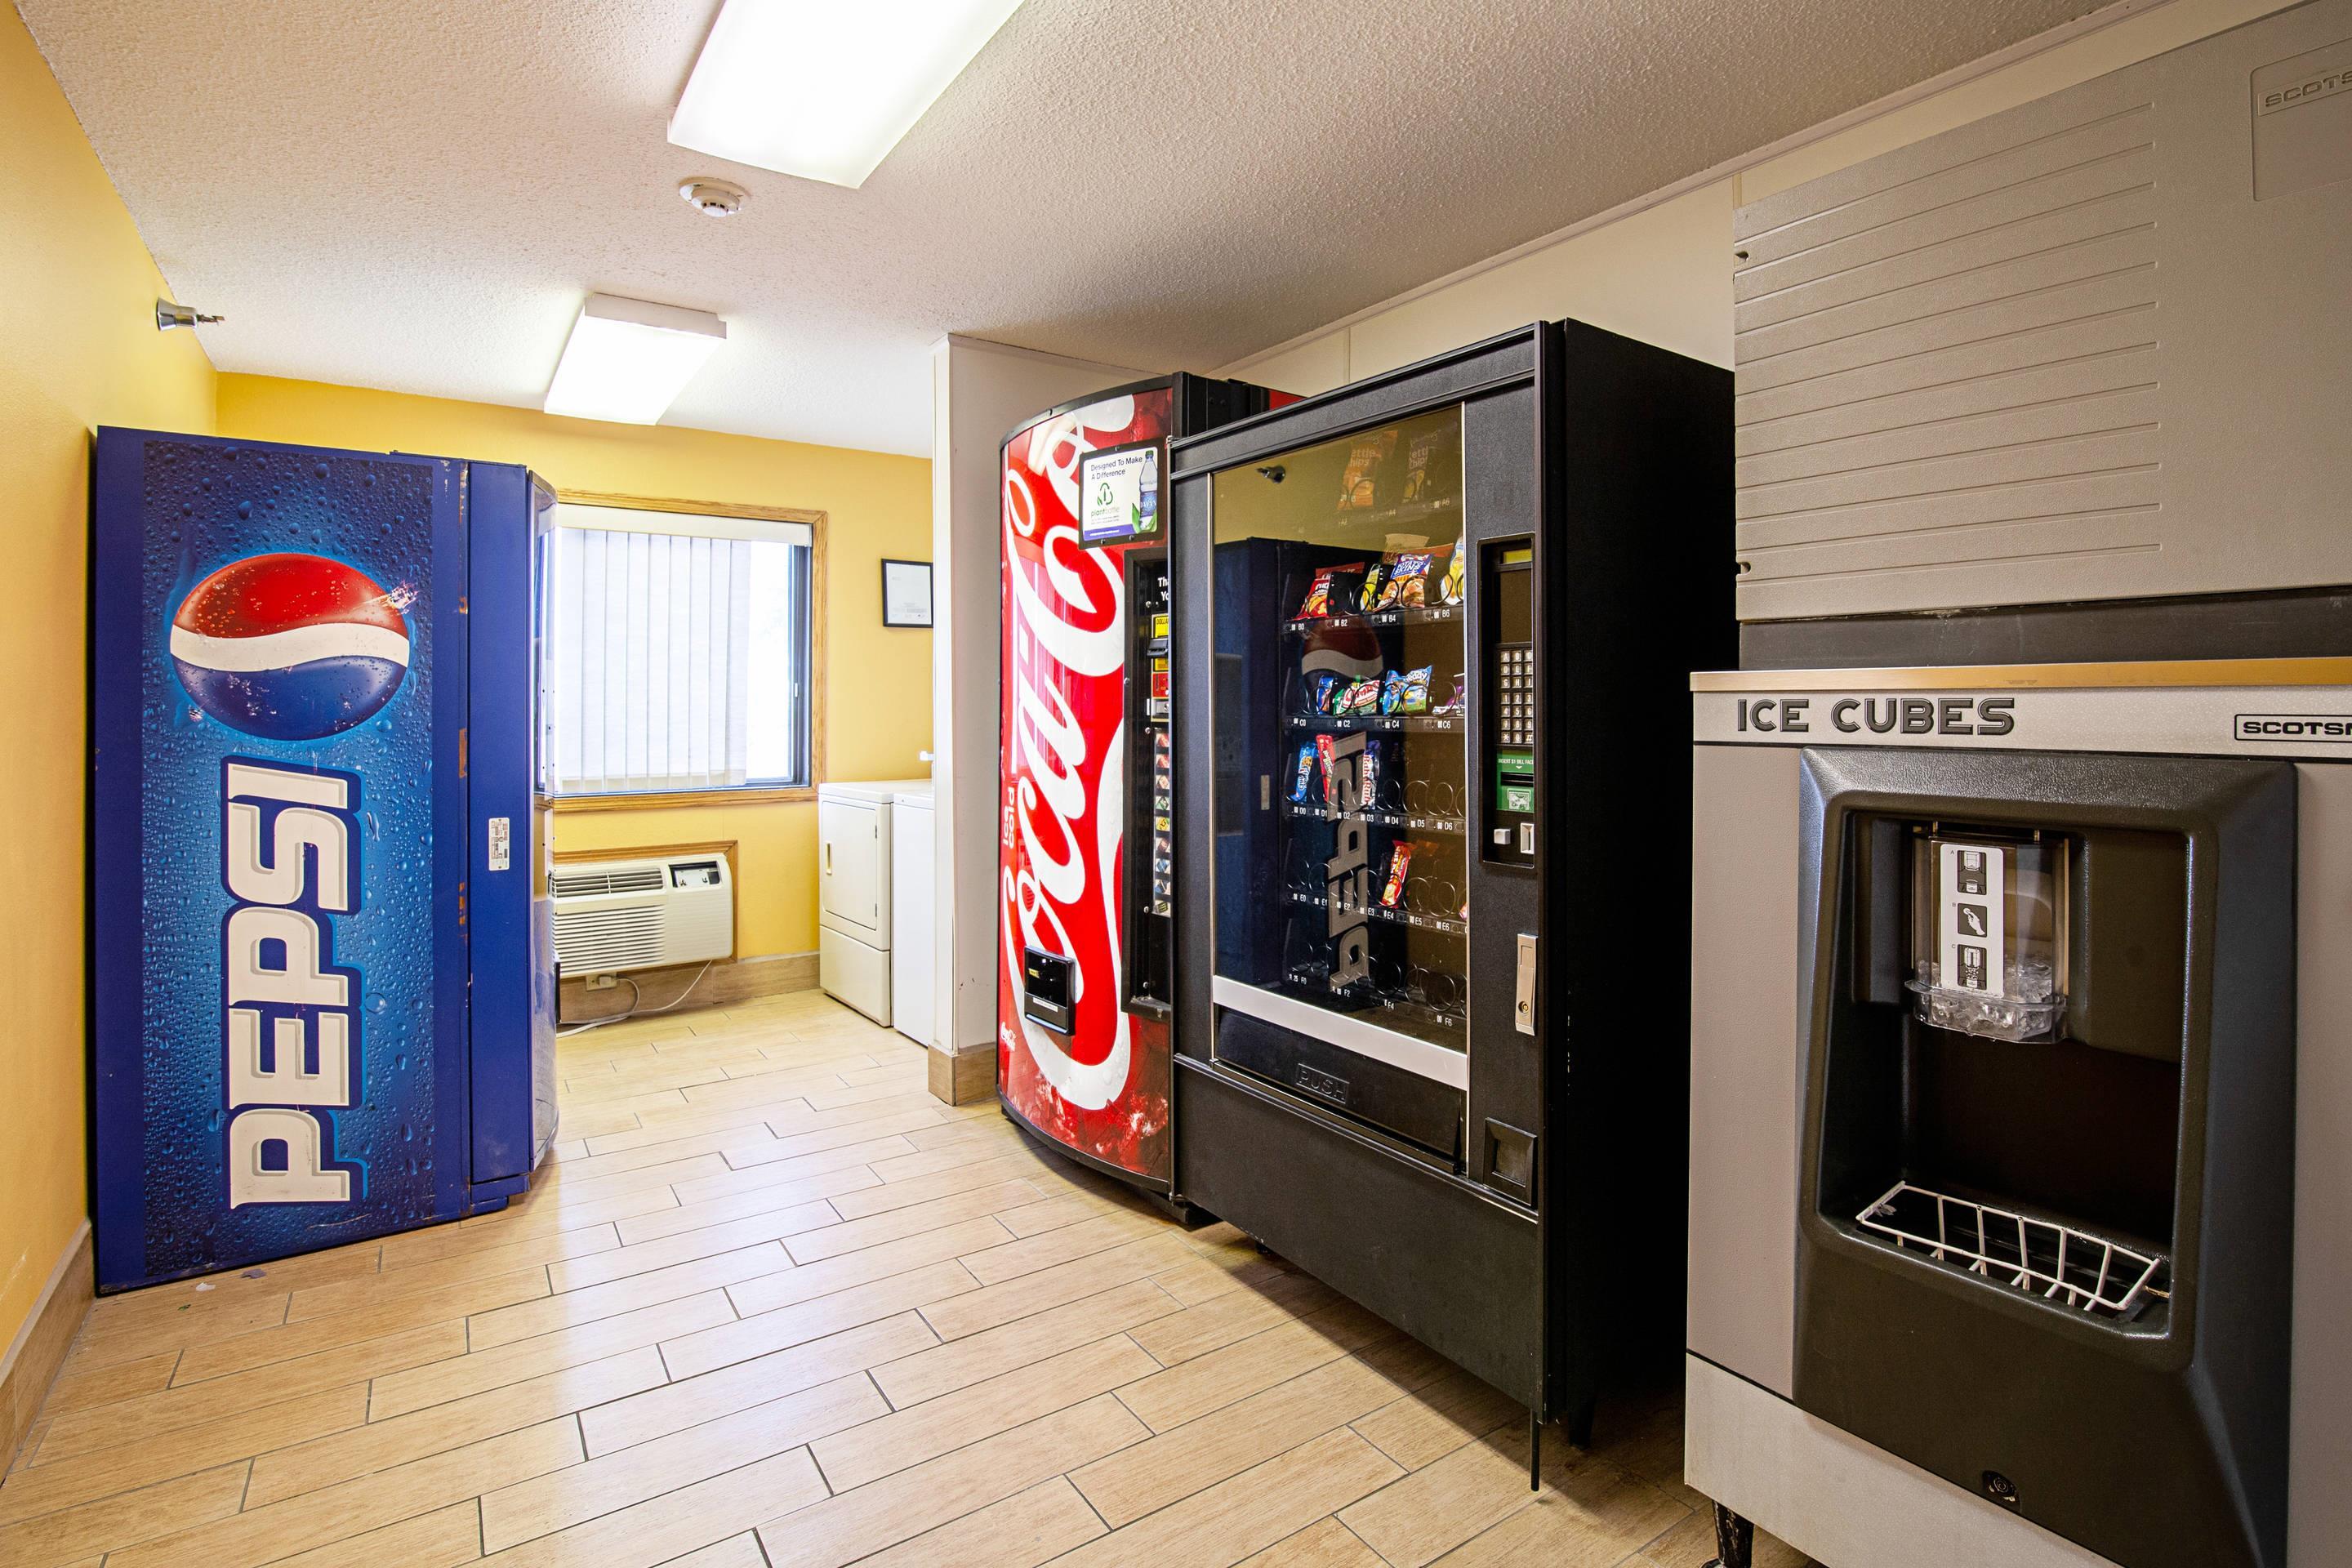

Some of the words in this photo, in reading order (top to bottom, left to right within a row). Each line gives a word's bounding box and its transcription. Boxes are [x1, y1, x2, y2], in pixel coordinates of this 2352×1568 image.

[1091, 460, 1116, 471] Designed
[1118, 458, 1125, 466] To
[1125, 457, 1143, 465] Make
[1096, 469, 1126, 479] Difference
[1737, 698, 1809, 733] ICE
[1830, 697, 2015, 736] CUBES
[1343, 719, 1351, 728] C2
[1392, 720, 1400, 728] C4
[1442, 720, 1450, 728] C6
[1387, 911, 1394, 920] E4
[227, 761, 351, 1209] PEPSI
[1445, 1018, 1453, 1027] F6
[1299, 1070, 1345, 1101] PUSH
